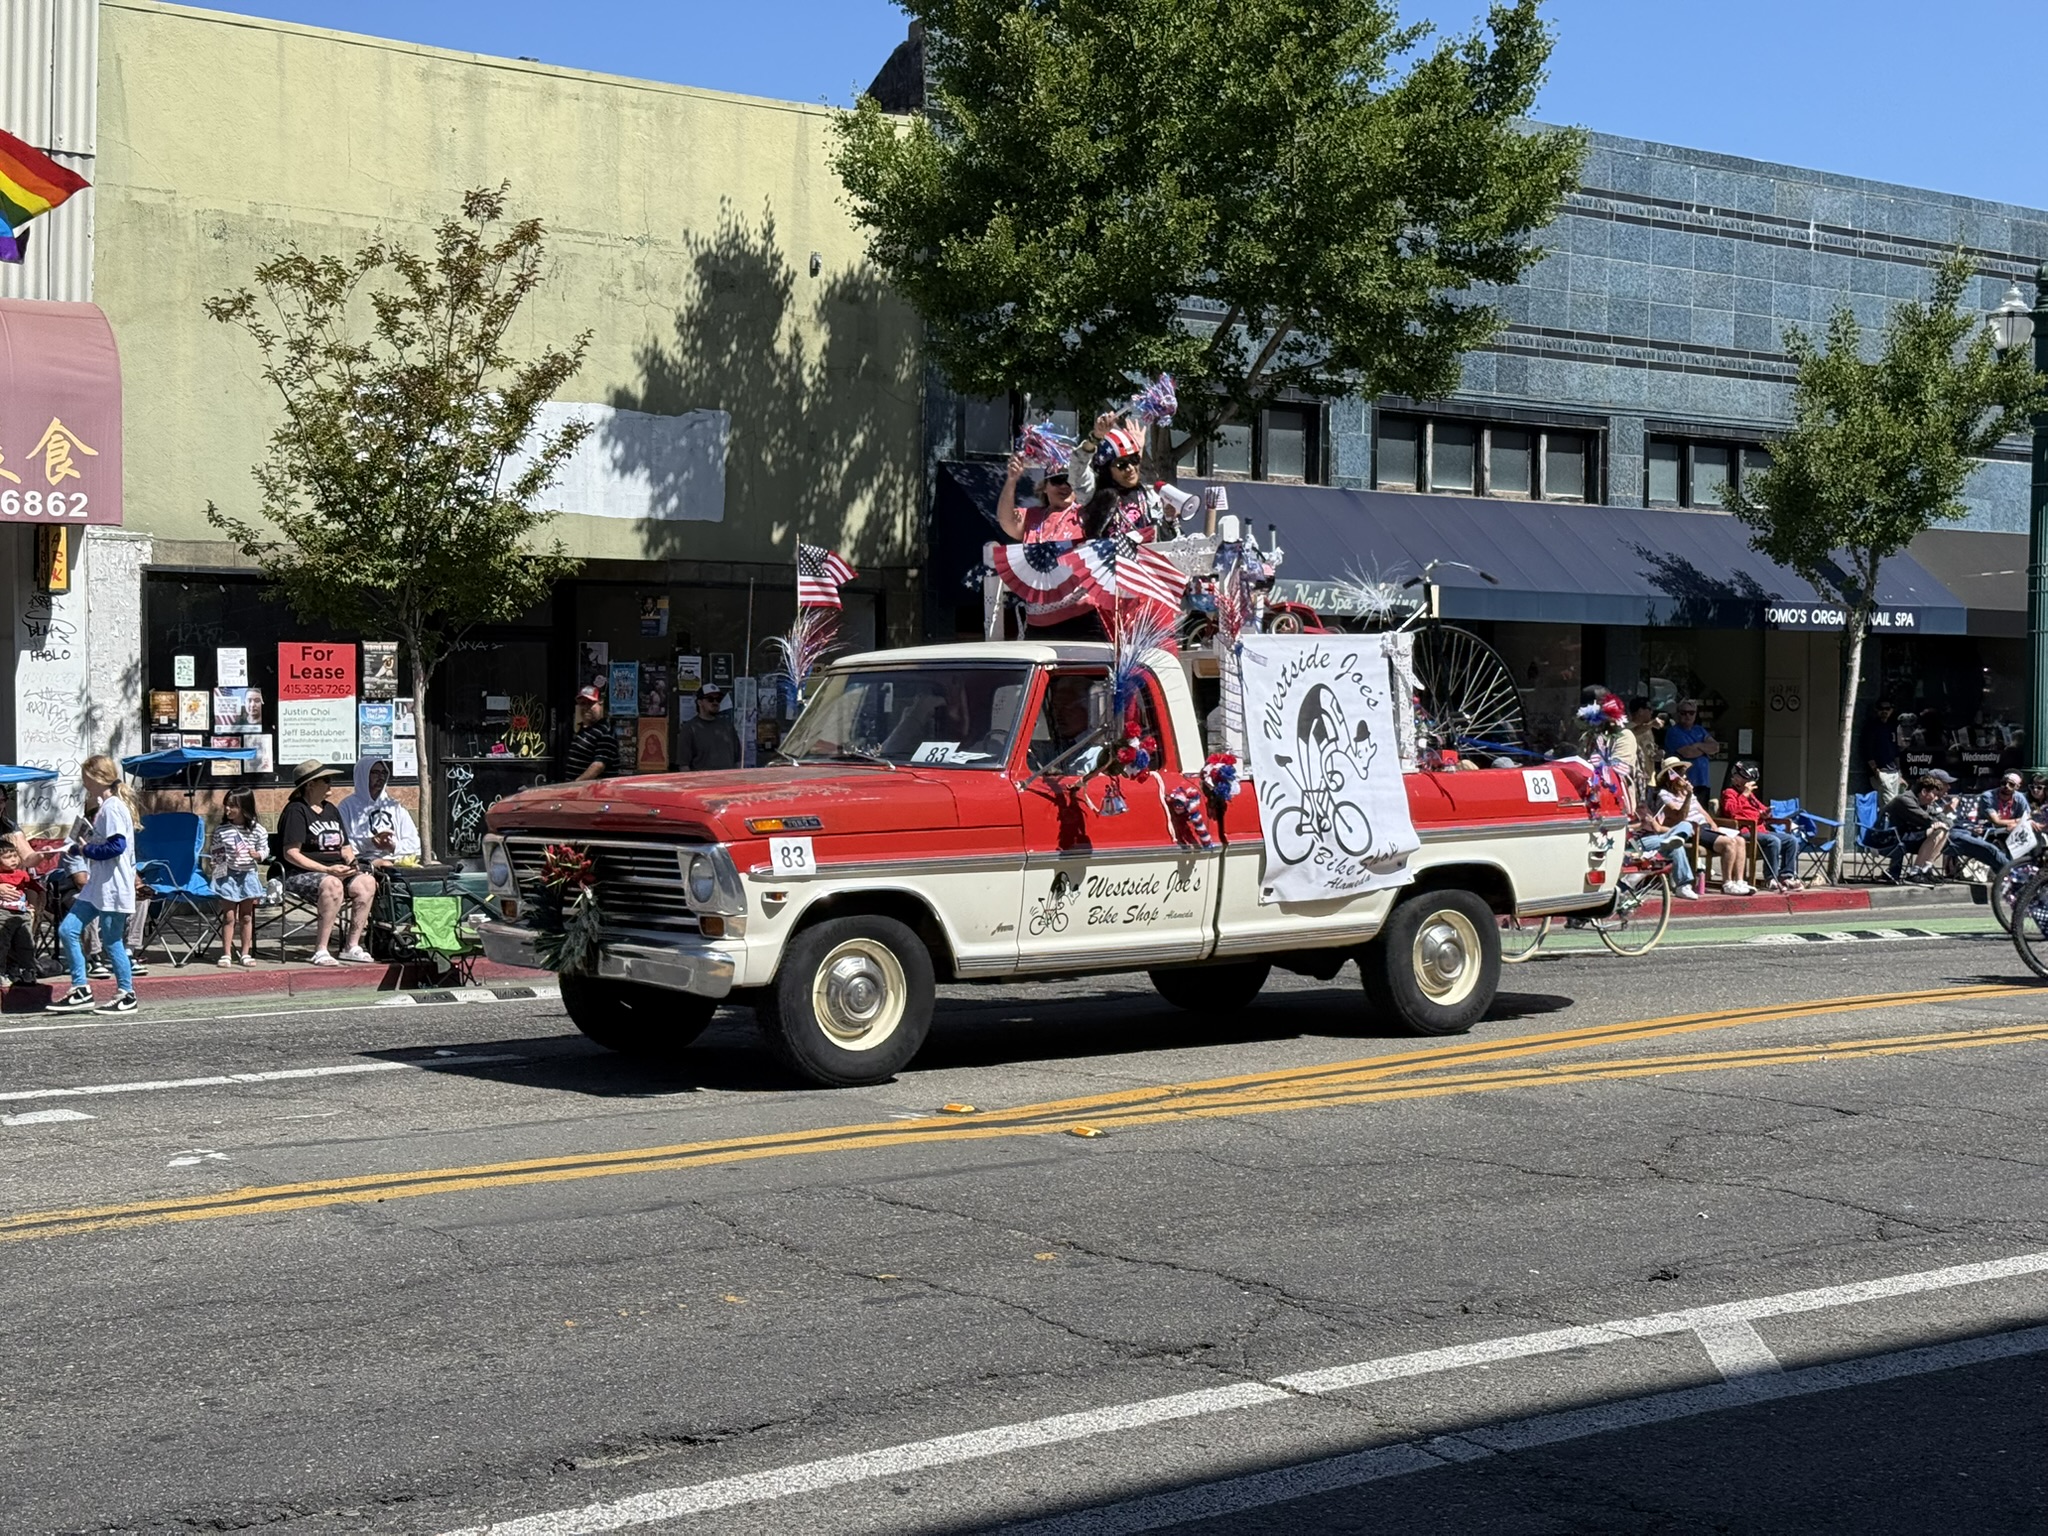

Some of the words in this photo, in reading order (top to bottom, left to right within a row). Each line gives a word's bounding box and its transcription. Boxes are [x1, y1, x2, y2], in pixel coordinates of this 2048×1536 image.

[0, 416, 99, 486] 食
[0, 489, 88, 517] 6862
[1295, 584, 1325, 609] Nail
[1328, 588, 1353, 614] Spa
[1765, 608, 1807, 624] TOMO'S
[1811, 609, 1847, 625] ORGA
[1867, 612, 1891, 626] NAIL
[1895, 612, 1914, 627] SPA
[301, 646, 334, 661] For
[290, 664, 345, 679] Lease
[283, 684, 352, 694] 415.395.7262
[1263, 643, 1331, 740] Westside
[1334, 653, 1384, 711] Joe's
[282, 708, 309, 716] Justin
[310, 707, 331, 716] Choi
[282, 728, 298, 737] Jeff
[300, 728, 346, 736] Badstubner
[342, 752, 354, 760] JLL
[925, 747, 949, 763] 83
[1906, 753, 1933, 764] Sunday
[1961, 752, 2000, 764] Wednesday
[1909, 766, 1918, 775] 10
[1973, 765, 1978, 774] 7
[1978, 766, 1990, 776] pm
[1532, 777, 1550, 795] 83
[781, 846, 806, 868] 83
[1313, 846, 1355, 876] Bike
[1356, 841, 1399, 875] Shop
[1087, 873, 1160, 898] Westside
[1163, 868, 1201, 903] Joe's
[1323, 874, 1371, 890] Alameda
[1087, 905, 1118, 925] Bike
[1122, 903, 1158, 926] Shop
[1164, 910, 1193, 919] Alameda
